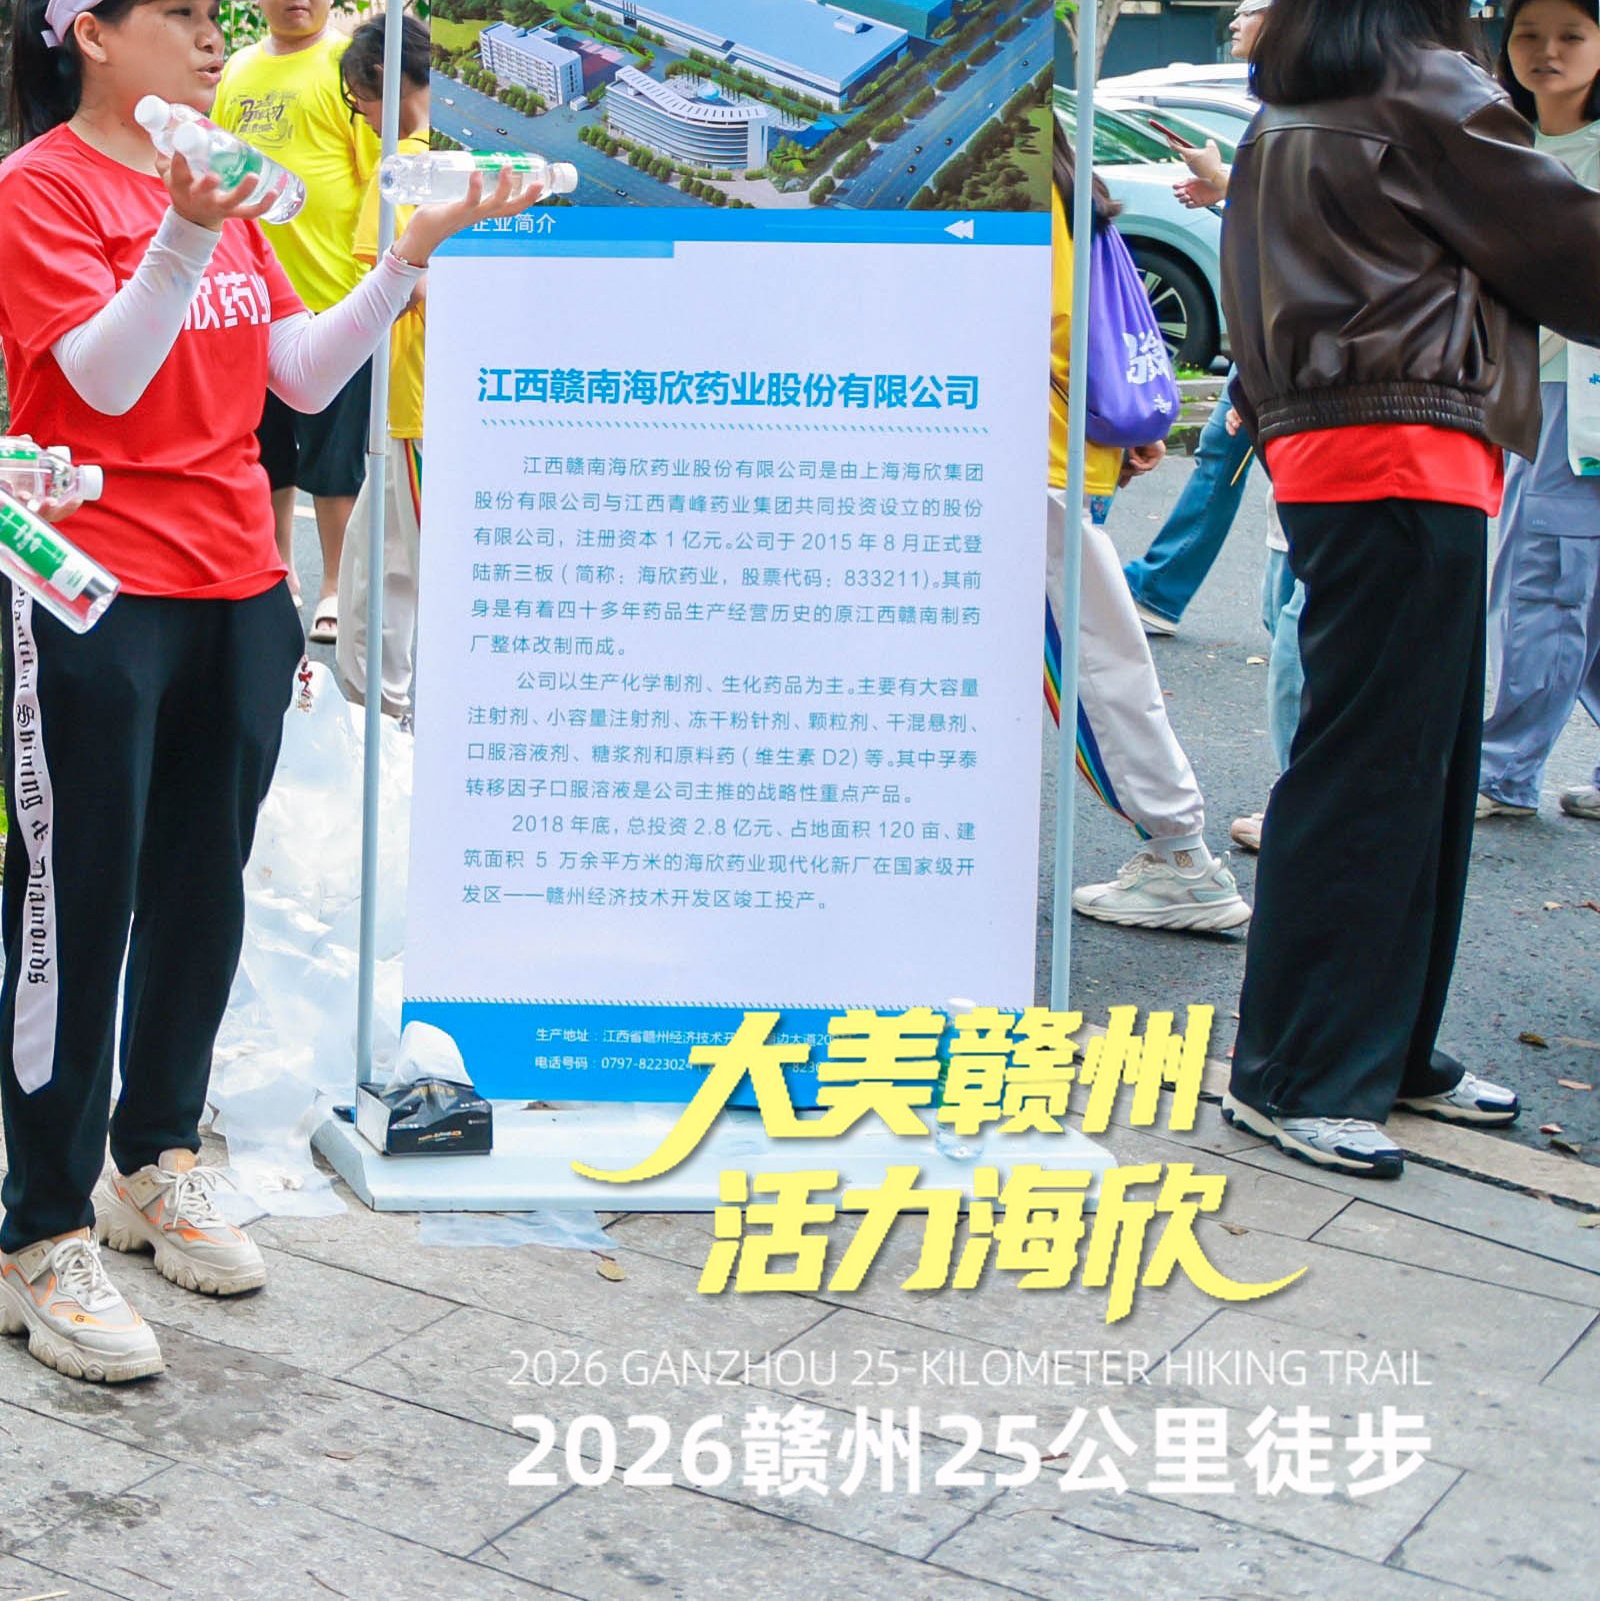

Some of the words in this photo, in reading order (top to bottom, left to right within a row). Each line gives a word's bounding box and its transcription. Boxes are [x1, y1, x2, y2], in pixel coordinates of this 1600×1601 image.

[477, 366, 980, 411] 江西赣南海欣药业股份有限公司
[523, 455, 985, 483] 江西赣南海欣药业股份有限公司是由上海海欣集团
[473, 490, 984, 519] 股份有限公司与江西青峰药业集团共同投资设立的股份
[471, 598, 981, 627] 身是有着四十多年药品生产经营历史的原江西赣南制药
[469, 633, 627, 658] 厂整体改制而成。
[516, 670, 980, 698] 公司以生产化学制剂、生化药品为主。主要有大容量
[465, 777, 913, 805] 转移因子口服溶液是公司主推的战略性重点产品。
